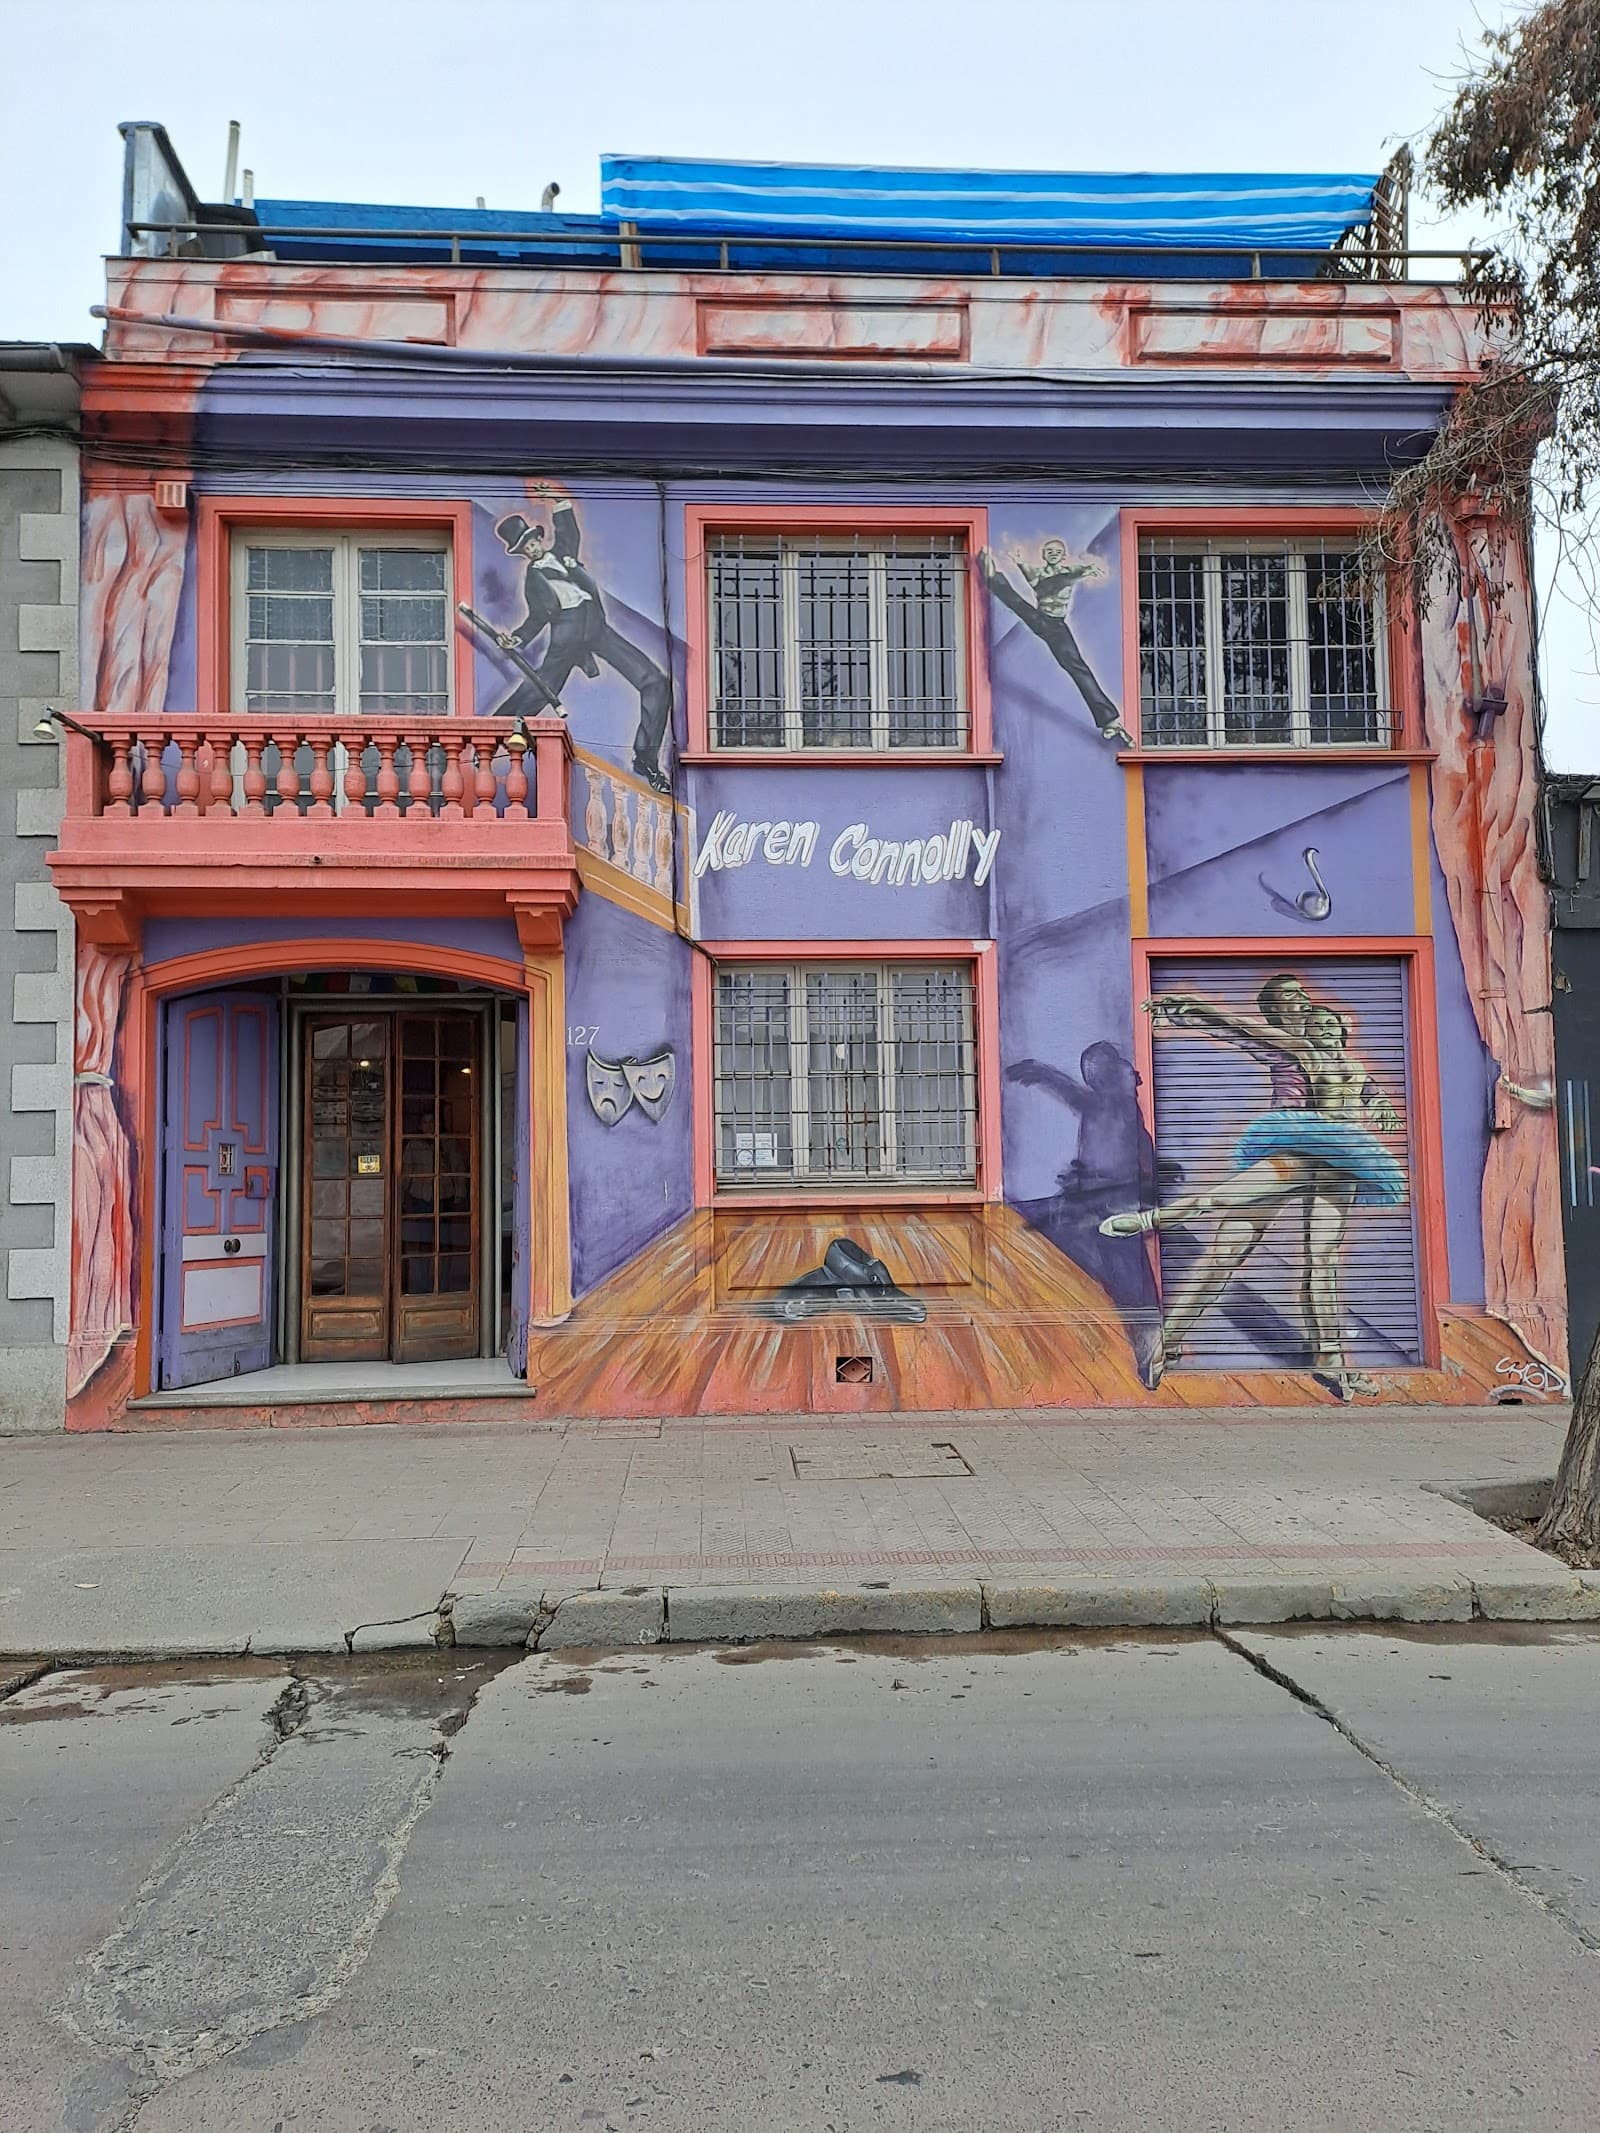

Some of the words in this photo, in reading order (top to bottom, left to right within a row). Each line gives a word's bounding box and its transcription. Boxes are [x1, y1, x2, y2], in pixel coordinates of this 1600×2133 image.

[693, 810, 820, 878] Karen
[829, 820, 1001, 886] Connolly
[567, 1025, 600, 1045] 127
